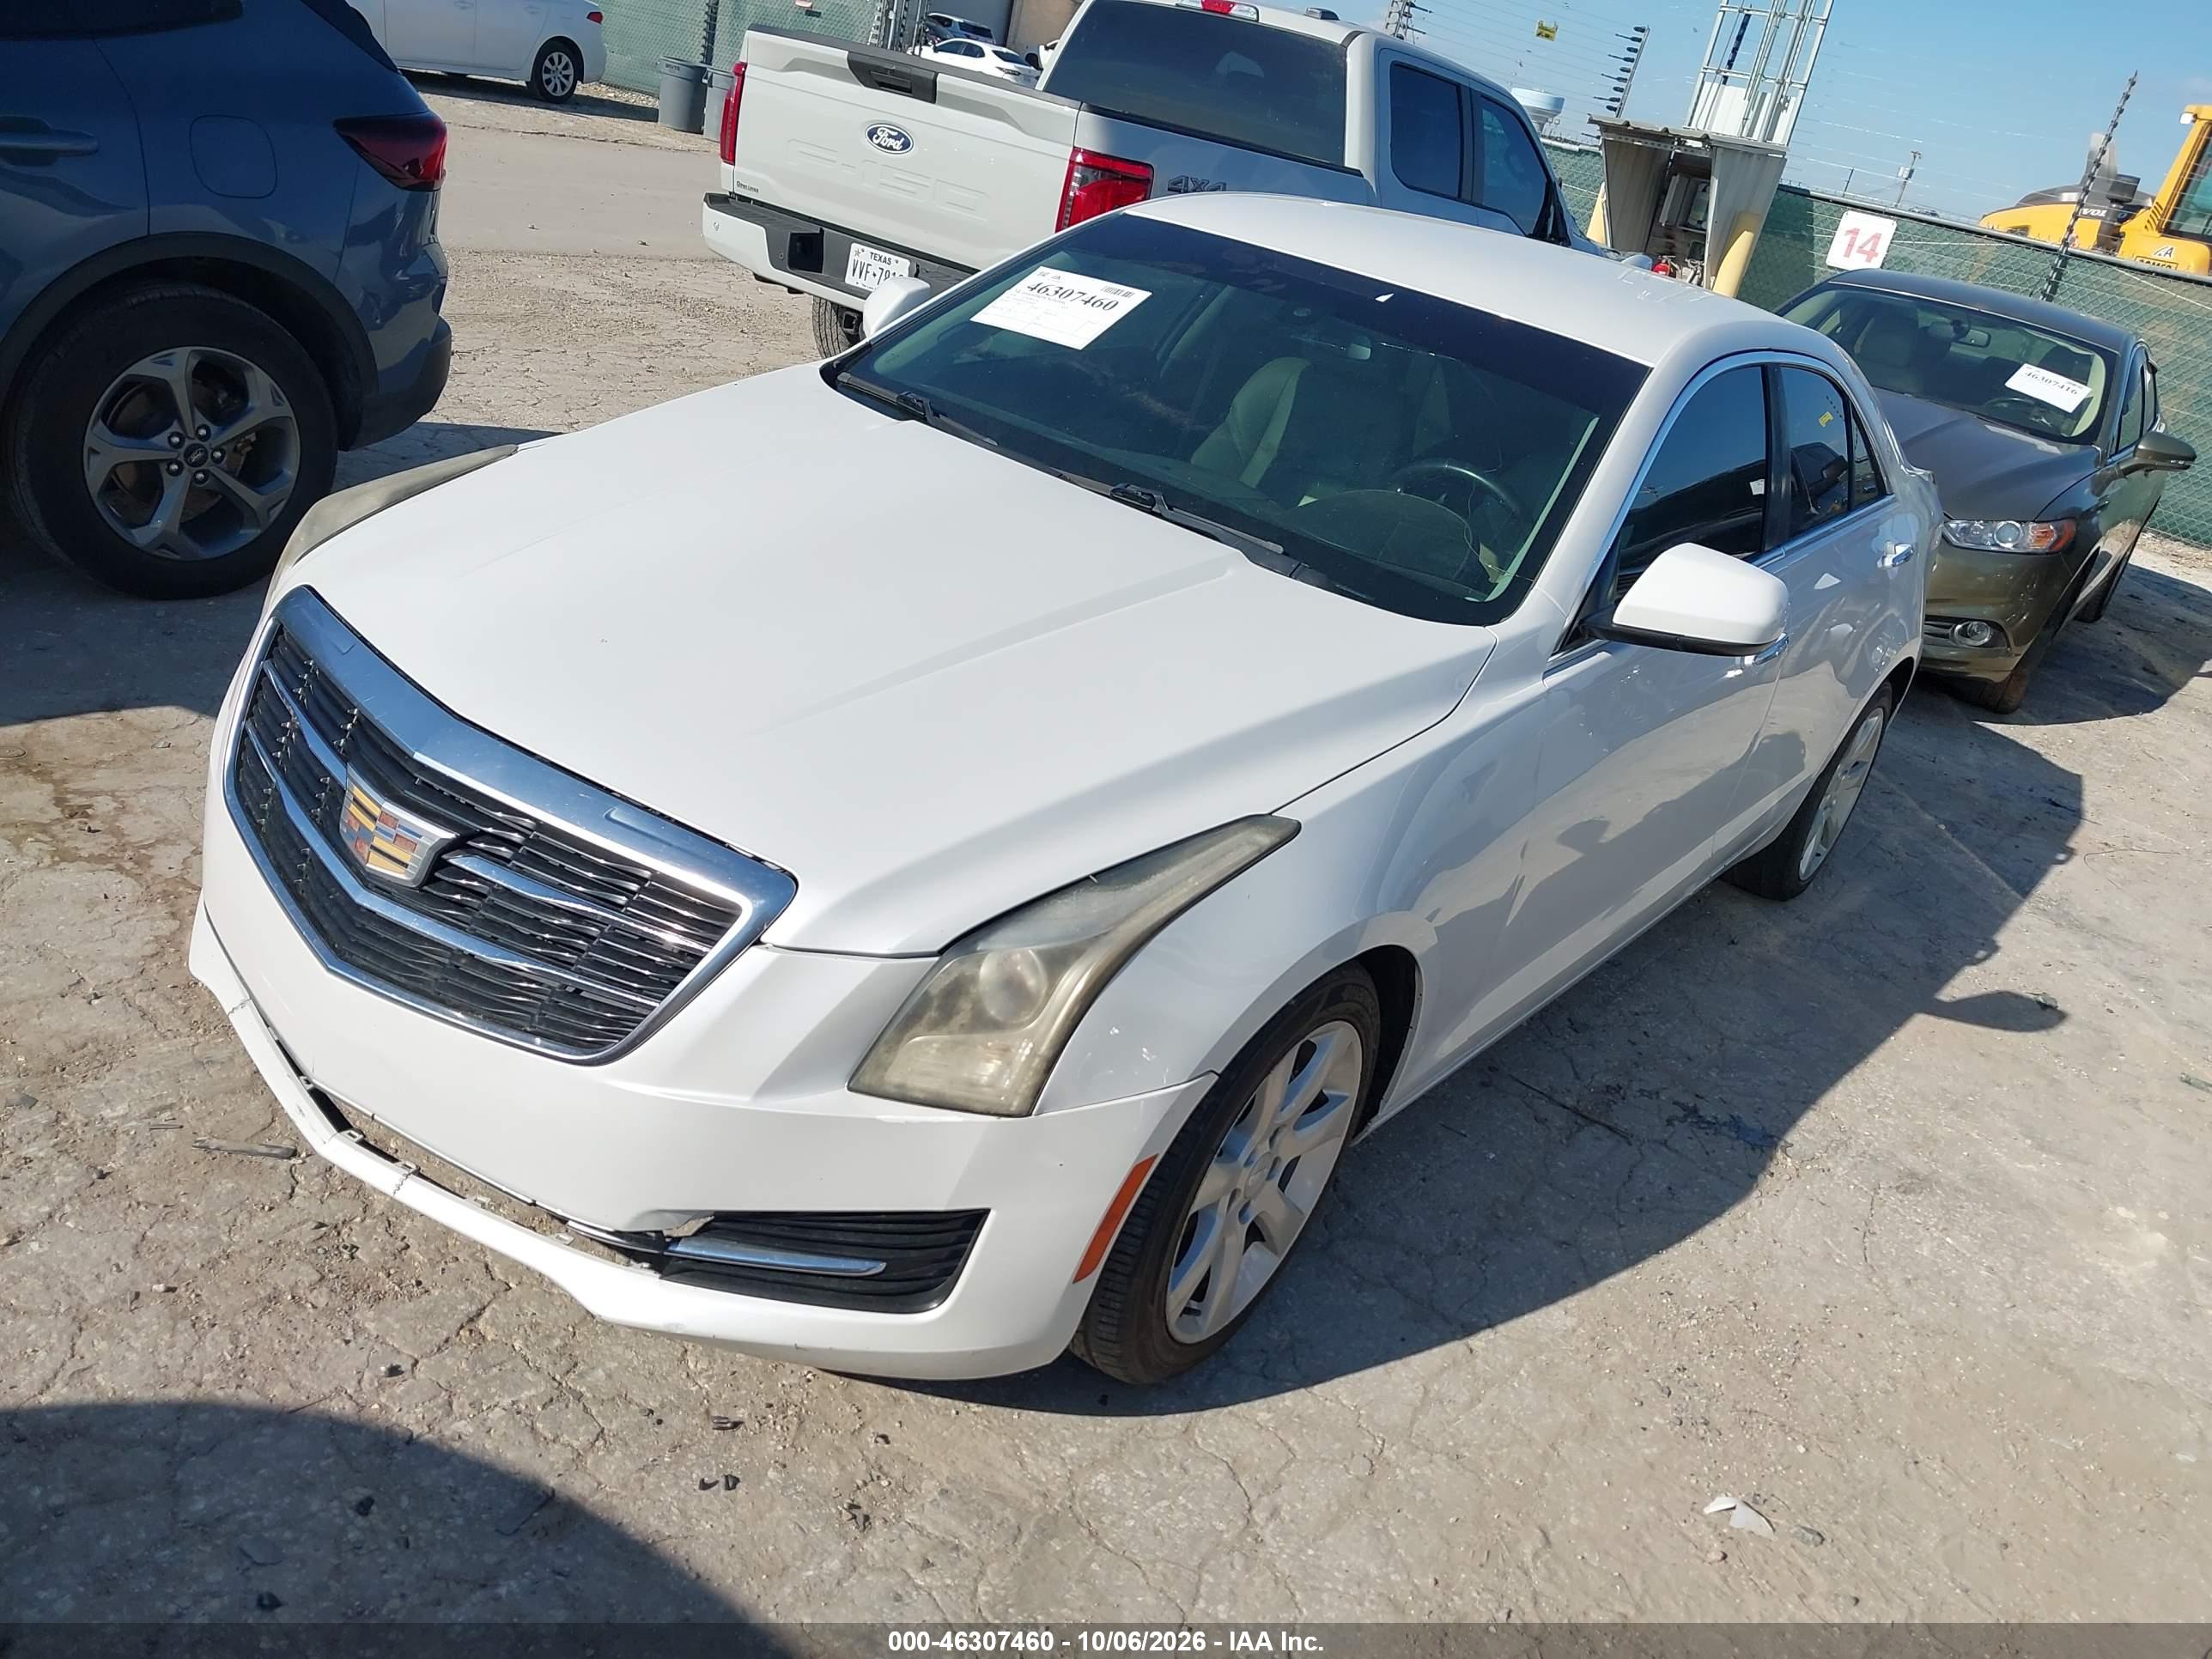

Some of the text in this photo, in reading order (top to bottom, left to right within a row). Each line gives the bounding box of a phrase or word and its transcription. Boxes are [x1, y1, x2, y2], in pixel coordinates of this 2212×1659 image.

[872, 127, 905, 150] Ford
[1843, 228, 1882, 263] 14
[870, 252, 892, 266] TEXAS
[1027, 282, 1119, 311] 46307460
